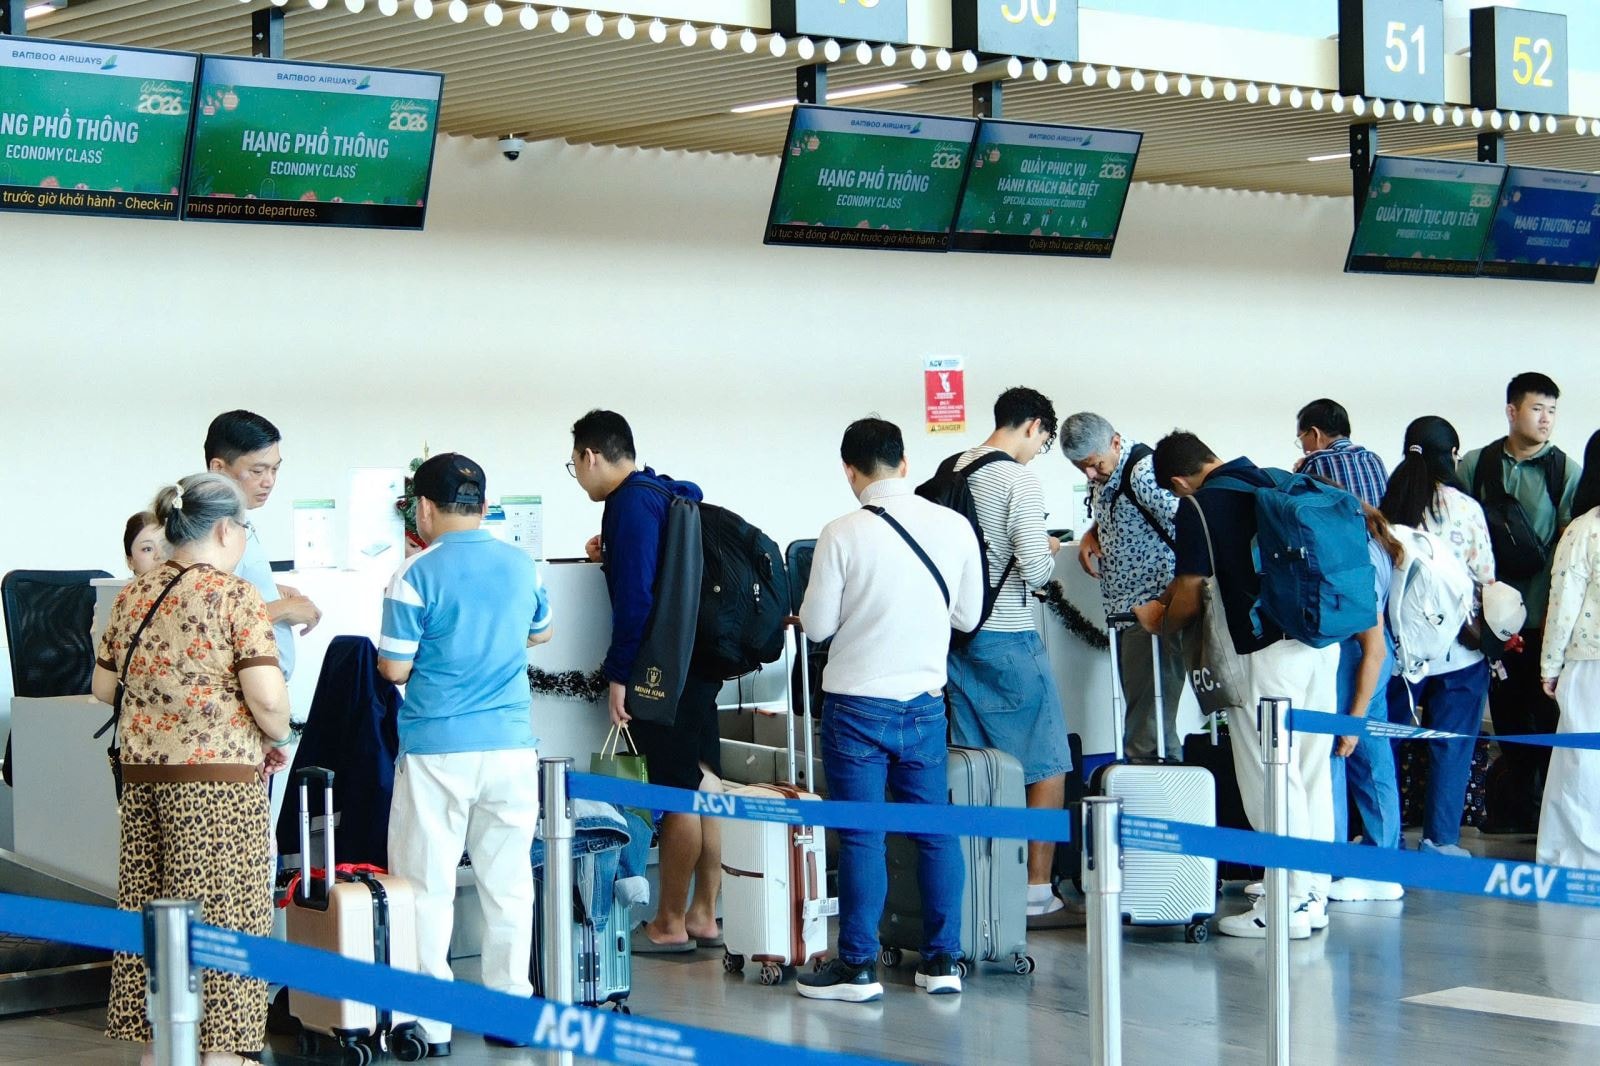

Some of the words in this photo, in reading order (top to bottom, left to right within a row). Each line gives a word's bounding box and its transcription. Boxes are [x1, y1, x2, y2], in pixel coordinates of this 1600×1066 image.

[12, 50, 56, 61] BAMBOO
[58, 54, 102, 65] AIRWAYS
[1385, 21, 1425, 75] 51
[1513, 36, 1553, 87] 52
[277, 73, 316, 83] BAMBOO
[318, 76, 357, 86] AIRWAYS
[137, 94, 182, 116] 2026
[32, 108, 71, 139] PHỔ
[76, 114, 139, 144] THÔNG
[388, 112, 427, 132] 2026
[850, 119, 880, 128] BAMBOO
[882, 122, 912, 130] AIRWAYS
[242, 130, 290, 157] HẠNG
[294, 126, 329, 155] PHỔ
[333, 132, 389, 159] THÔNG
[6, 144, 65, 161] ECONOMY
[65, 148, 102, 164] CLASS
[931, 152, 961, 169] 2026
[270, 161, 321, 176] ECONOMY
[323, 164, 356, 179] CLASS
[817, 168, 855, 191] HẠNG
[857, 165, 885, 190] PHỔ
[886, 170, 929, 192] THÔNG
[1099, 163, 1127, 179] 2026
[3, 191, 35, 204] trước
[38, 192, 56, 207] giờ
[60, 191, 83, 206] khởi
[87, 193, 115, 208] hành
[125, 197, 173, 211] Check-in
[187, 201, 214, 213] mins
[217, 202, 242, 215] prior
[245, 204, 255, 215] to
[258, 204, 318, 217] departures.
[836, 194, 877, 208] ECONOMY
[877, 197, 902, 209] CLASS
[829, 231, 838, 240] 40
[692, 791, 735, 816] ACV
[1483, 862, 1558, 899] ACV
[532, 1002, 606, 1055] ACV
